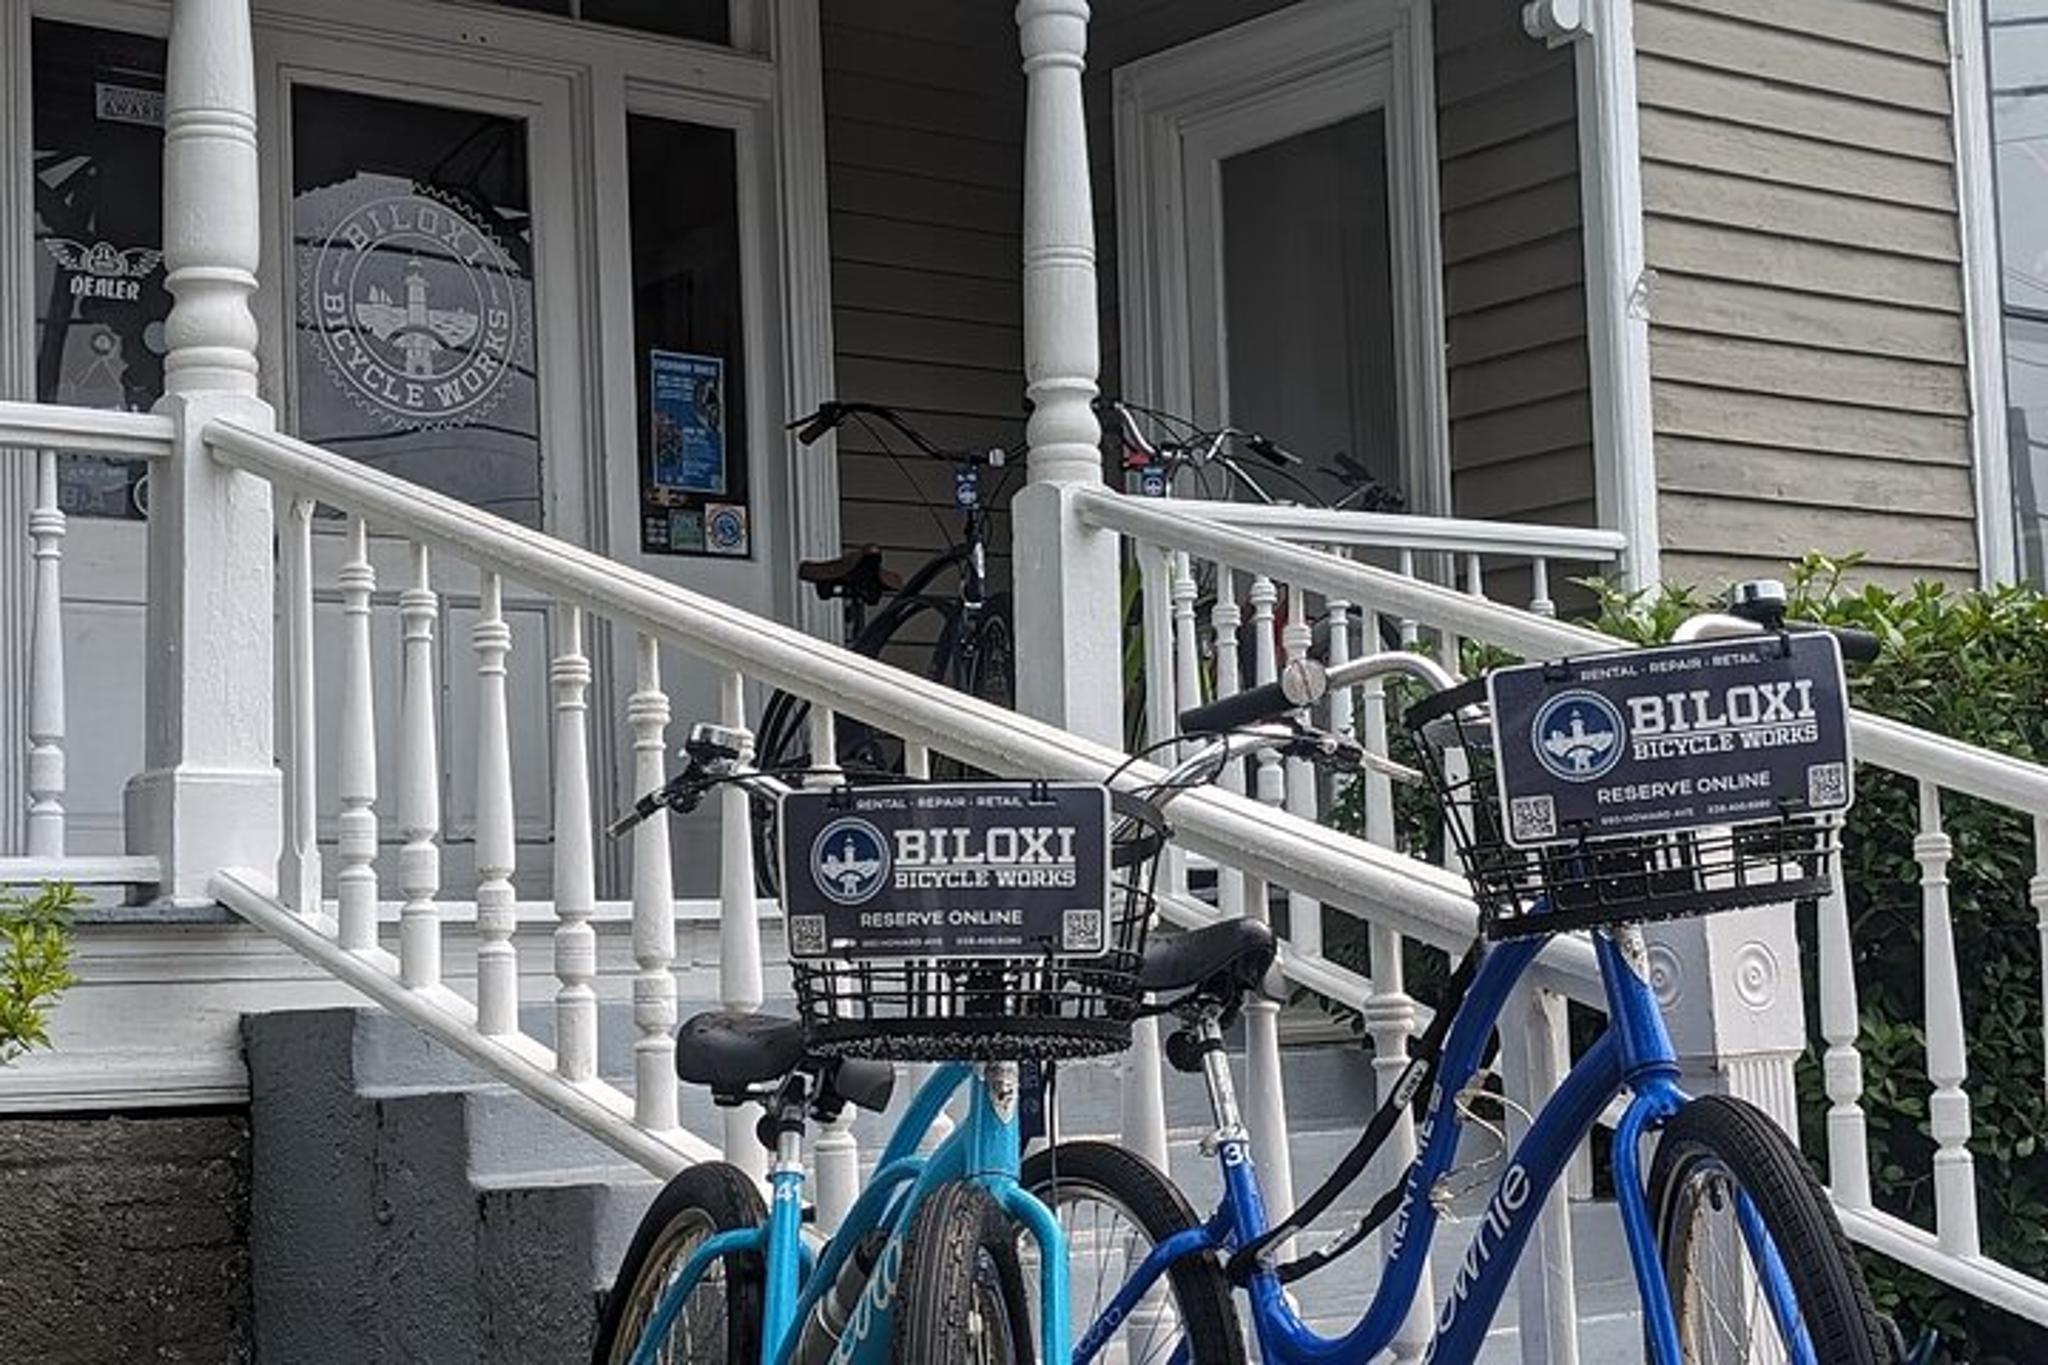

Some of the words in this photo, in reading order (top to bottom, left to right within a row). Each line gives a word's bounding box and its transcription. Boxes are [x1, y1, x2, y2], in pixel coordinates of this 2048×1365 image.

[343, 204, 487, 267] BILOXI
[70, 276, 141, 300] DEALER
[323, 291, 426, 407] BICYCLE
[434, 309, 509, 408] WORKS
[1581, 665, 1638, 680] RENTAL
[1650, 659, 1701, 673] REPAIR
[1712, 653, 1761, 667] RETAIL
[1627, 679, 1815, 733] BILOXI
[1632, 733, 1734, 760] BICYCLE
[1740, 723, 1820, 749] WORKS
[856, 798, 906, 811] RENTAL
[918, 797, 965, 809] REPAIR
[976, 795, 1023, 808] RETAIL
[1597, 778, 1693, 804] RESERVE
[1697, 770, 1771, 793] ONLINE
[894, 828, 1076, 865] BILOXI
[895, 869, 989, 889] BICYCLE
[996, 869, 1076, 887] WORKS
[860, 911, 944, 928] RESERVE
[949, 909, 1023, 926] ONLINE
